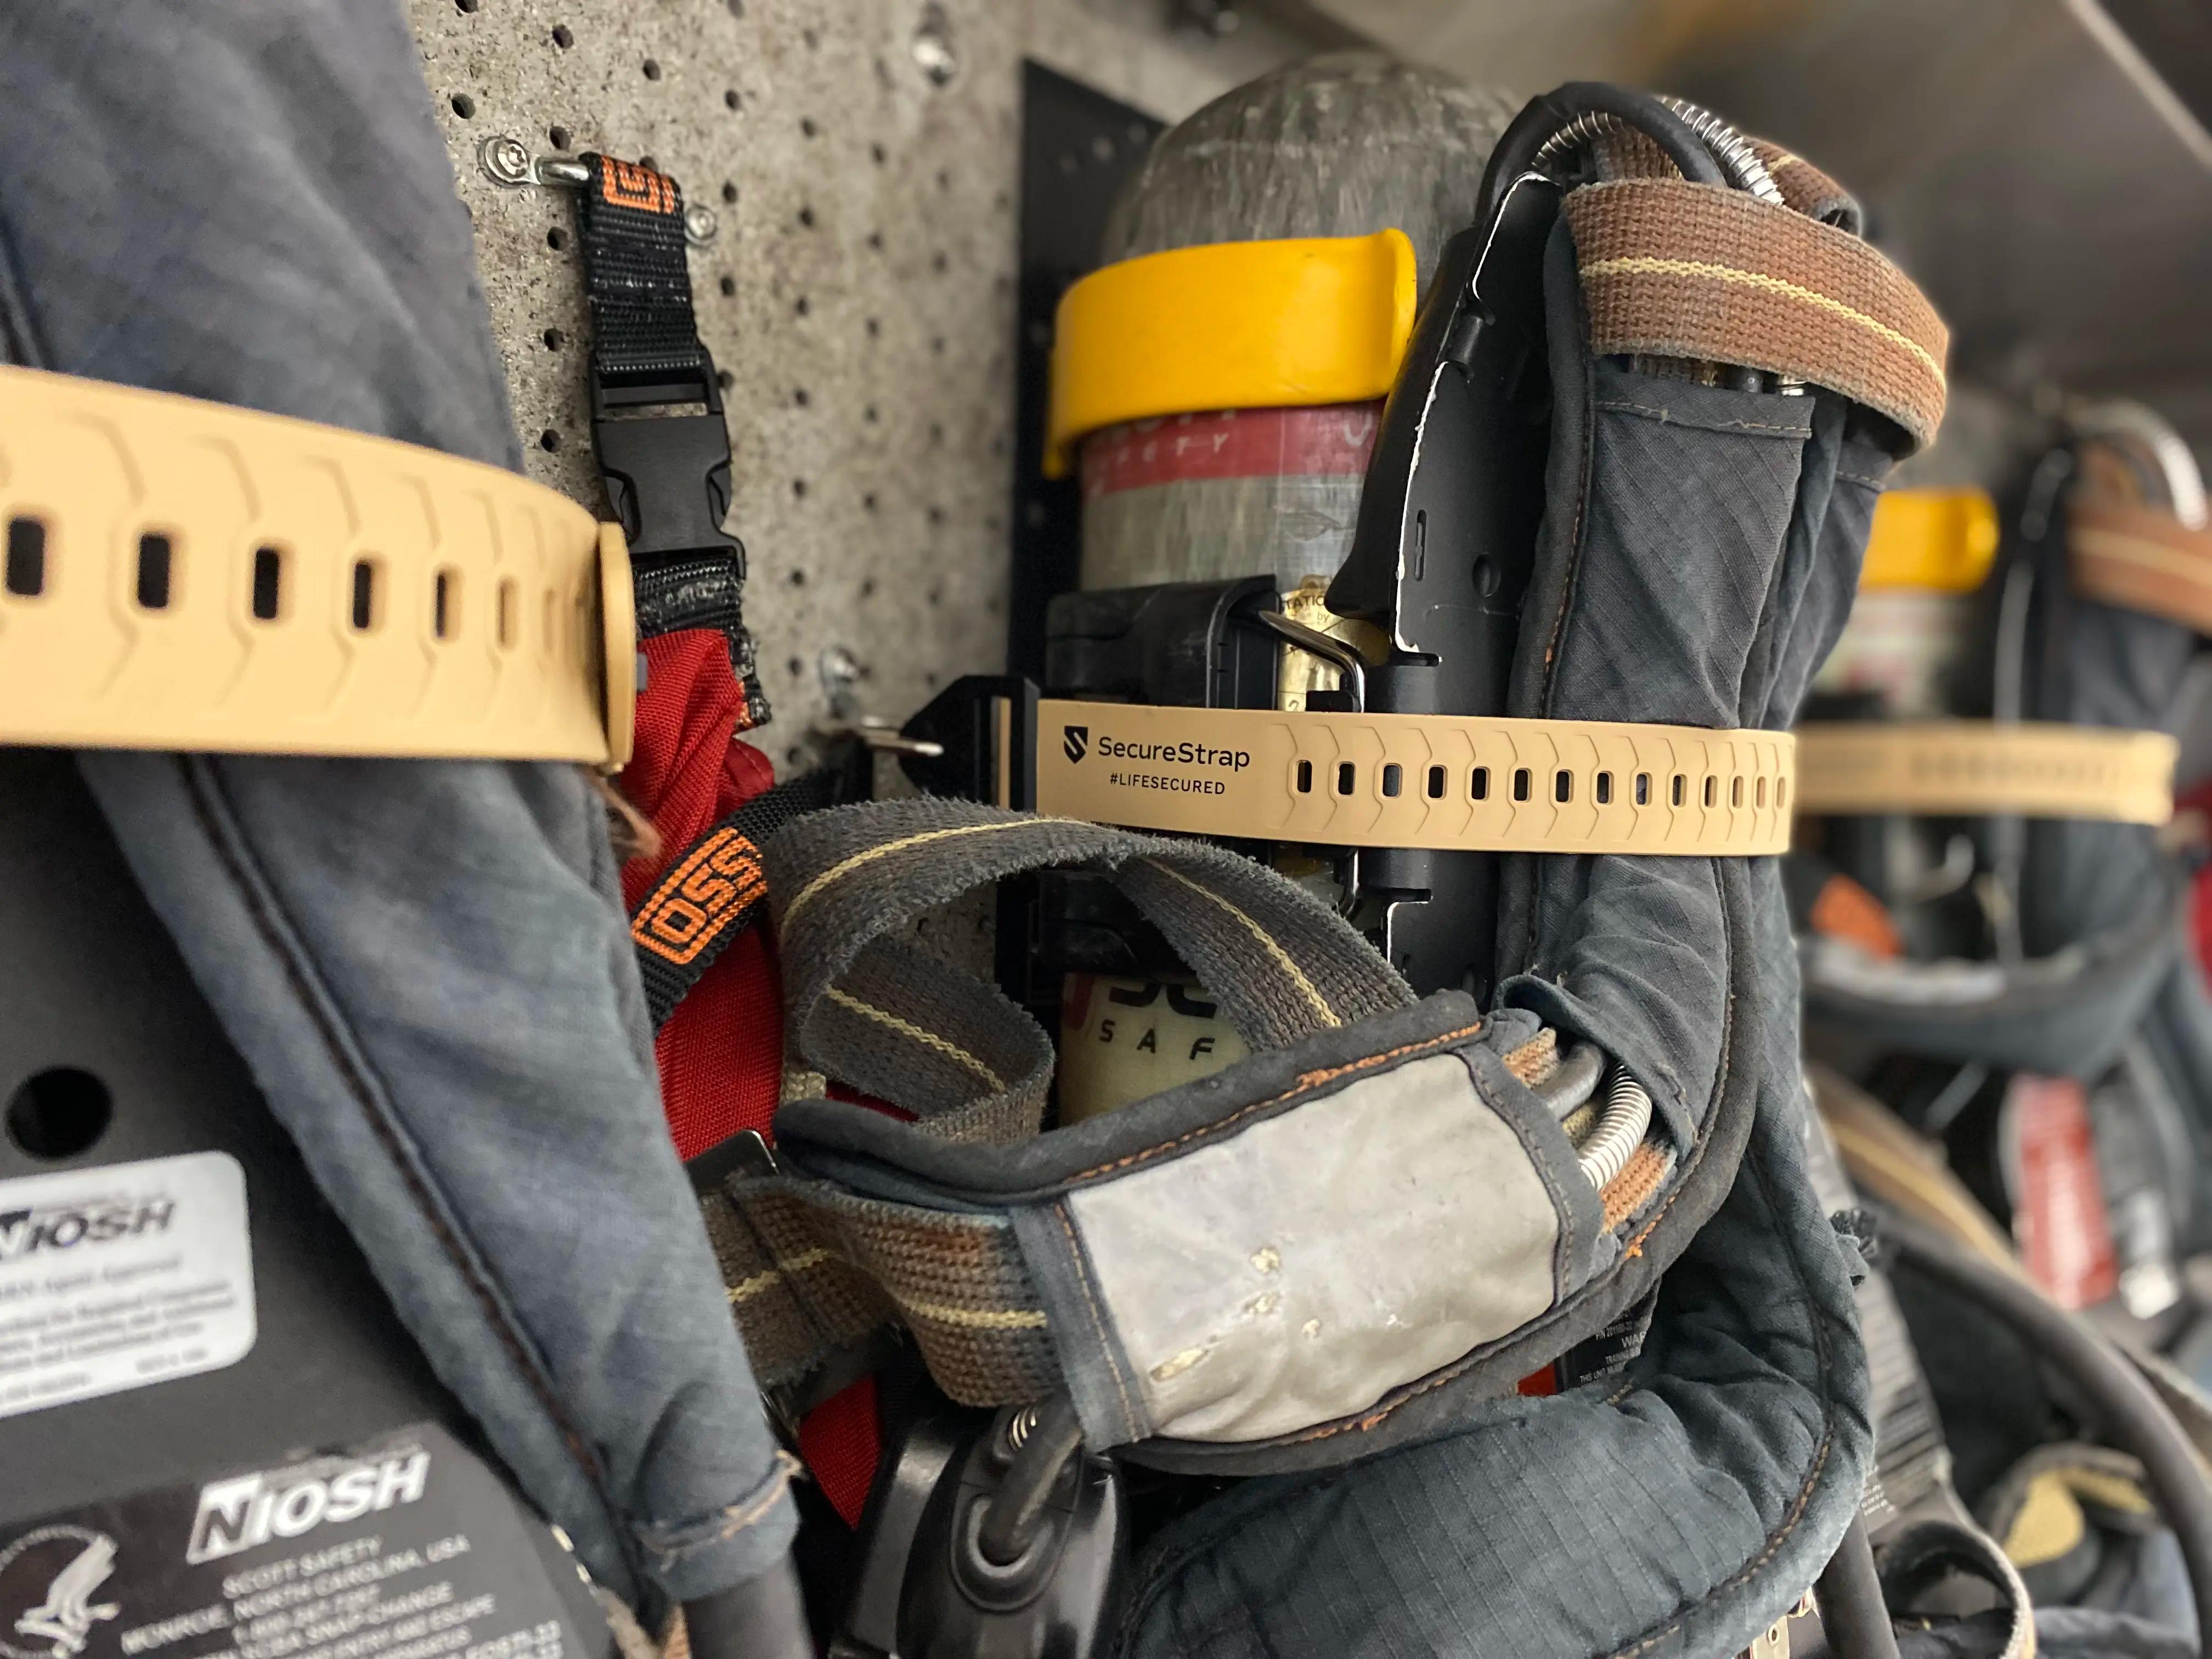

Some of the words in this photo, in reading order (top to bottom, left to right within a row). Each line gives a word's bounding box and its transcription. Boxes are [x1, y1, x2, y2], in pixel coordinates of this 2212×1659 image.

[1317, 612, 1330, 623] by
[1098, 736, 1250, 772] SecureStrap
[1110, 772, 1226, 794] #LIFESECURED
[1579, 1373, 1592, 1383] THIS
[186, 1451, 432, 1565] NIOSH
[223, 1559, 297, 1599] SCOTT
[299, 1534, 382, 1577] SAFETY
